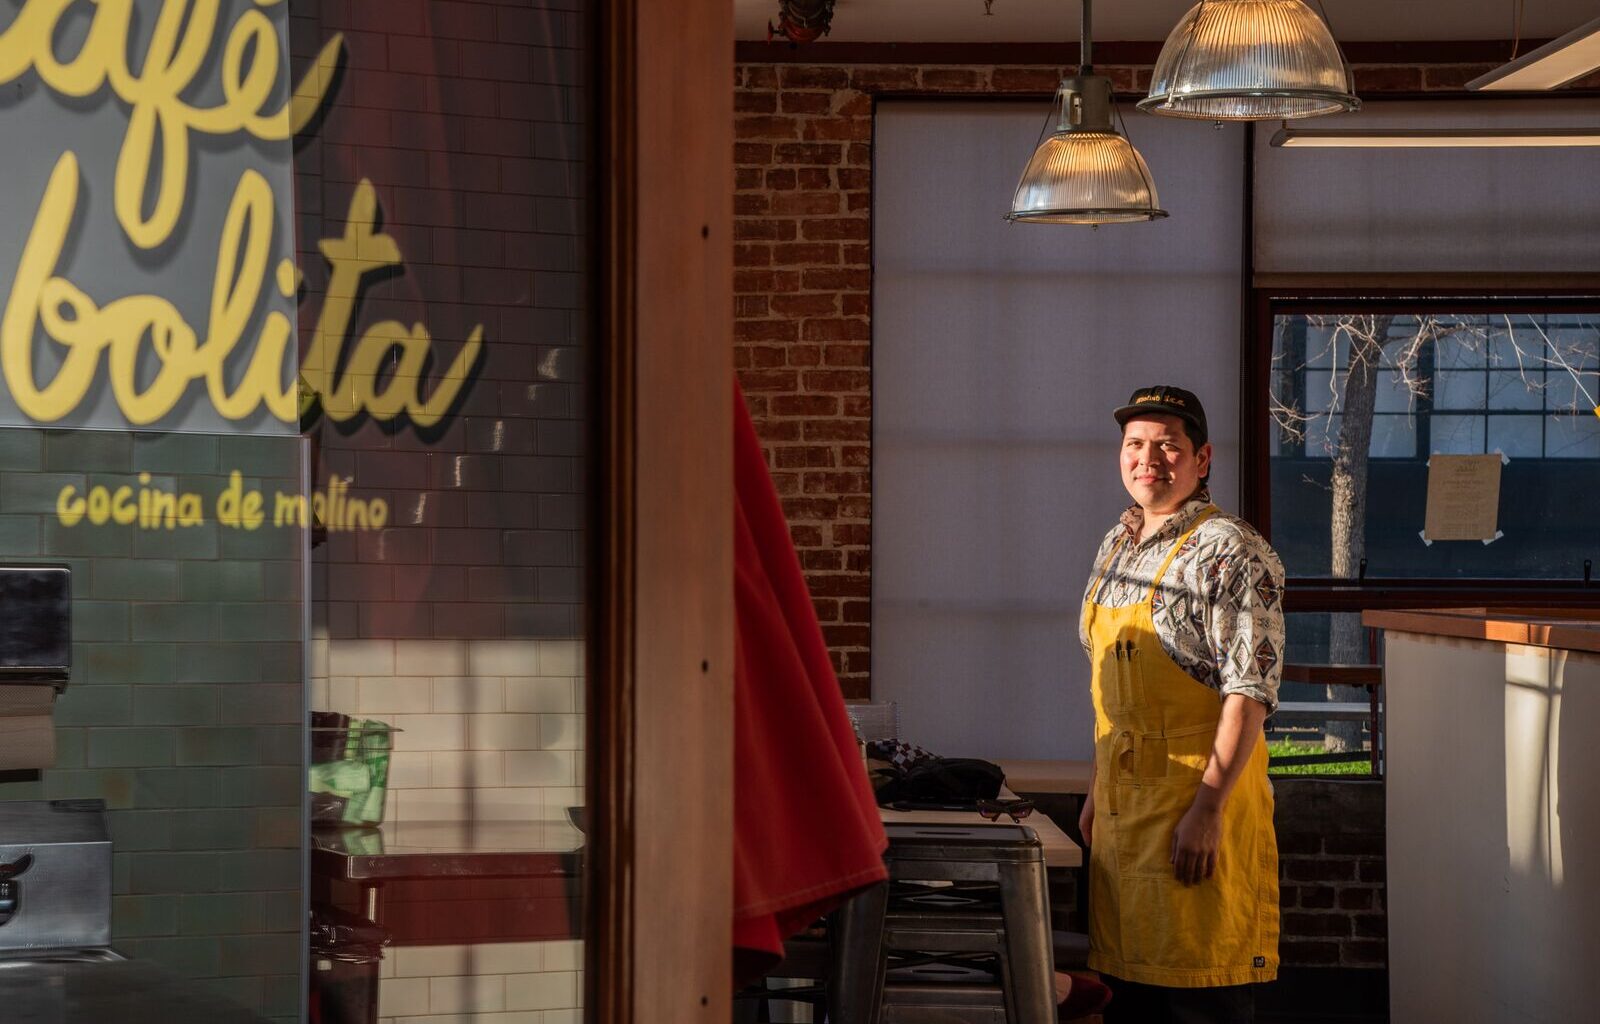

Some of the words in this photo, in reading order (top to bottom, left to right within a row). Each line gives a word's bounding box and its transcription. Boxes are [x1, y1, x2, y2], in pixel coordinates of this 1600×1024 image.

[2, 150, 484, 427] bolita
[56, 472, 203, 530] cocina
[216, 469, 264, 530] de
[274, 474, 388, 532] molino
